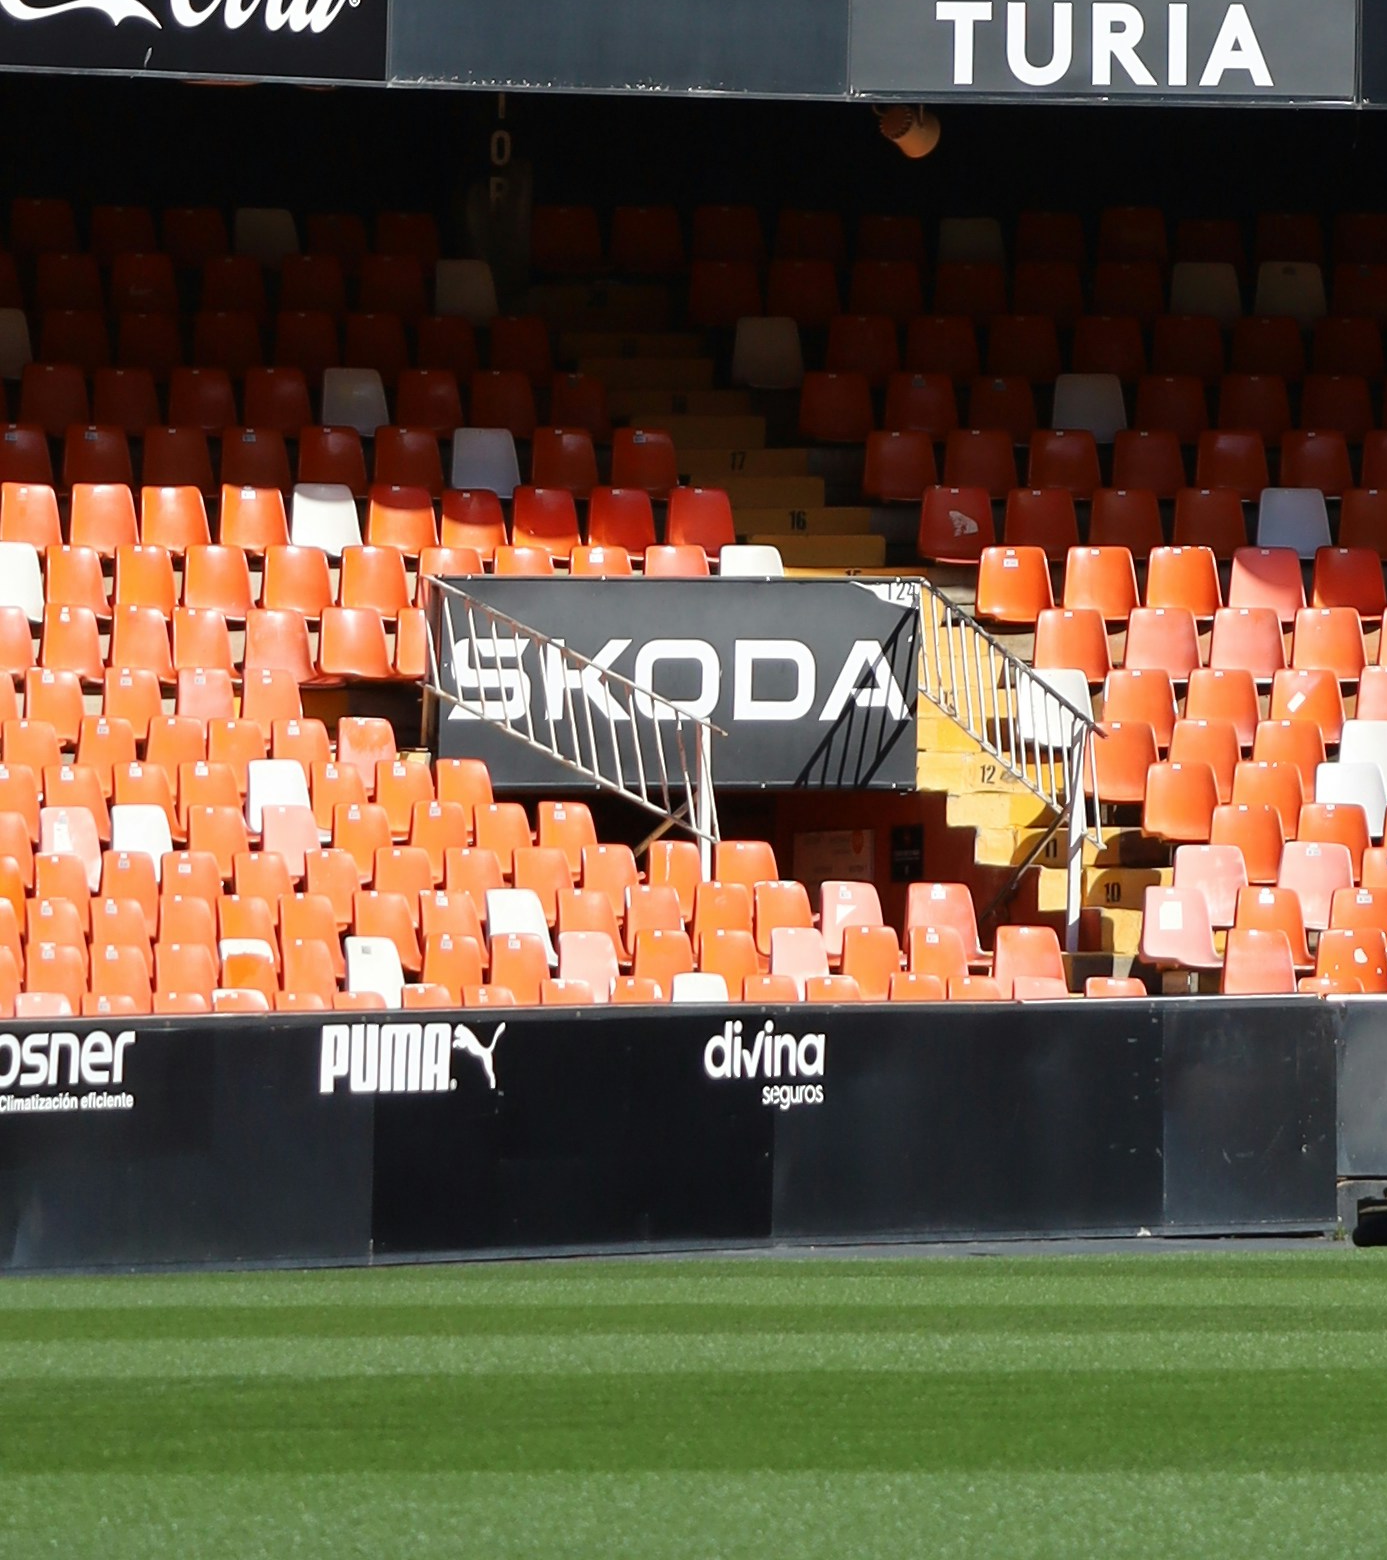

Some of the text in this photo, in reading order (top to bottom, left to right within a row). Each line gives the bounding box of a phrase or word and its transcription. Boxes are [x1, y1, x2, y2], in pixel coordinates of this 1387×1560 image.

[935, 1, 1274, 87] TURIA
[730, 453, 746, 470] 17
[790, 511, 807, 530] 16
[980, 765, 996, 785] 12
[1104, 882, 1121, 902] 10
[320, 1023, 451, 1093] PUMA
[704, 1020, 825, 1081] divina
[81, 1091, 134, 1110] eficiente
[762, 1082, 825, 1109] seguros
